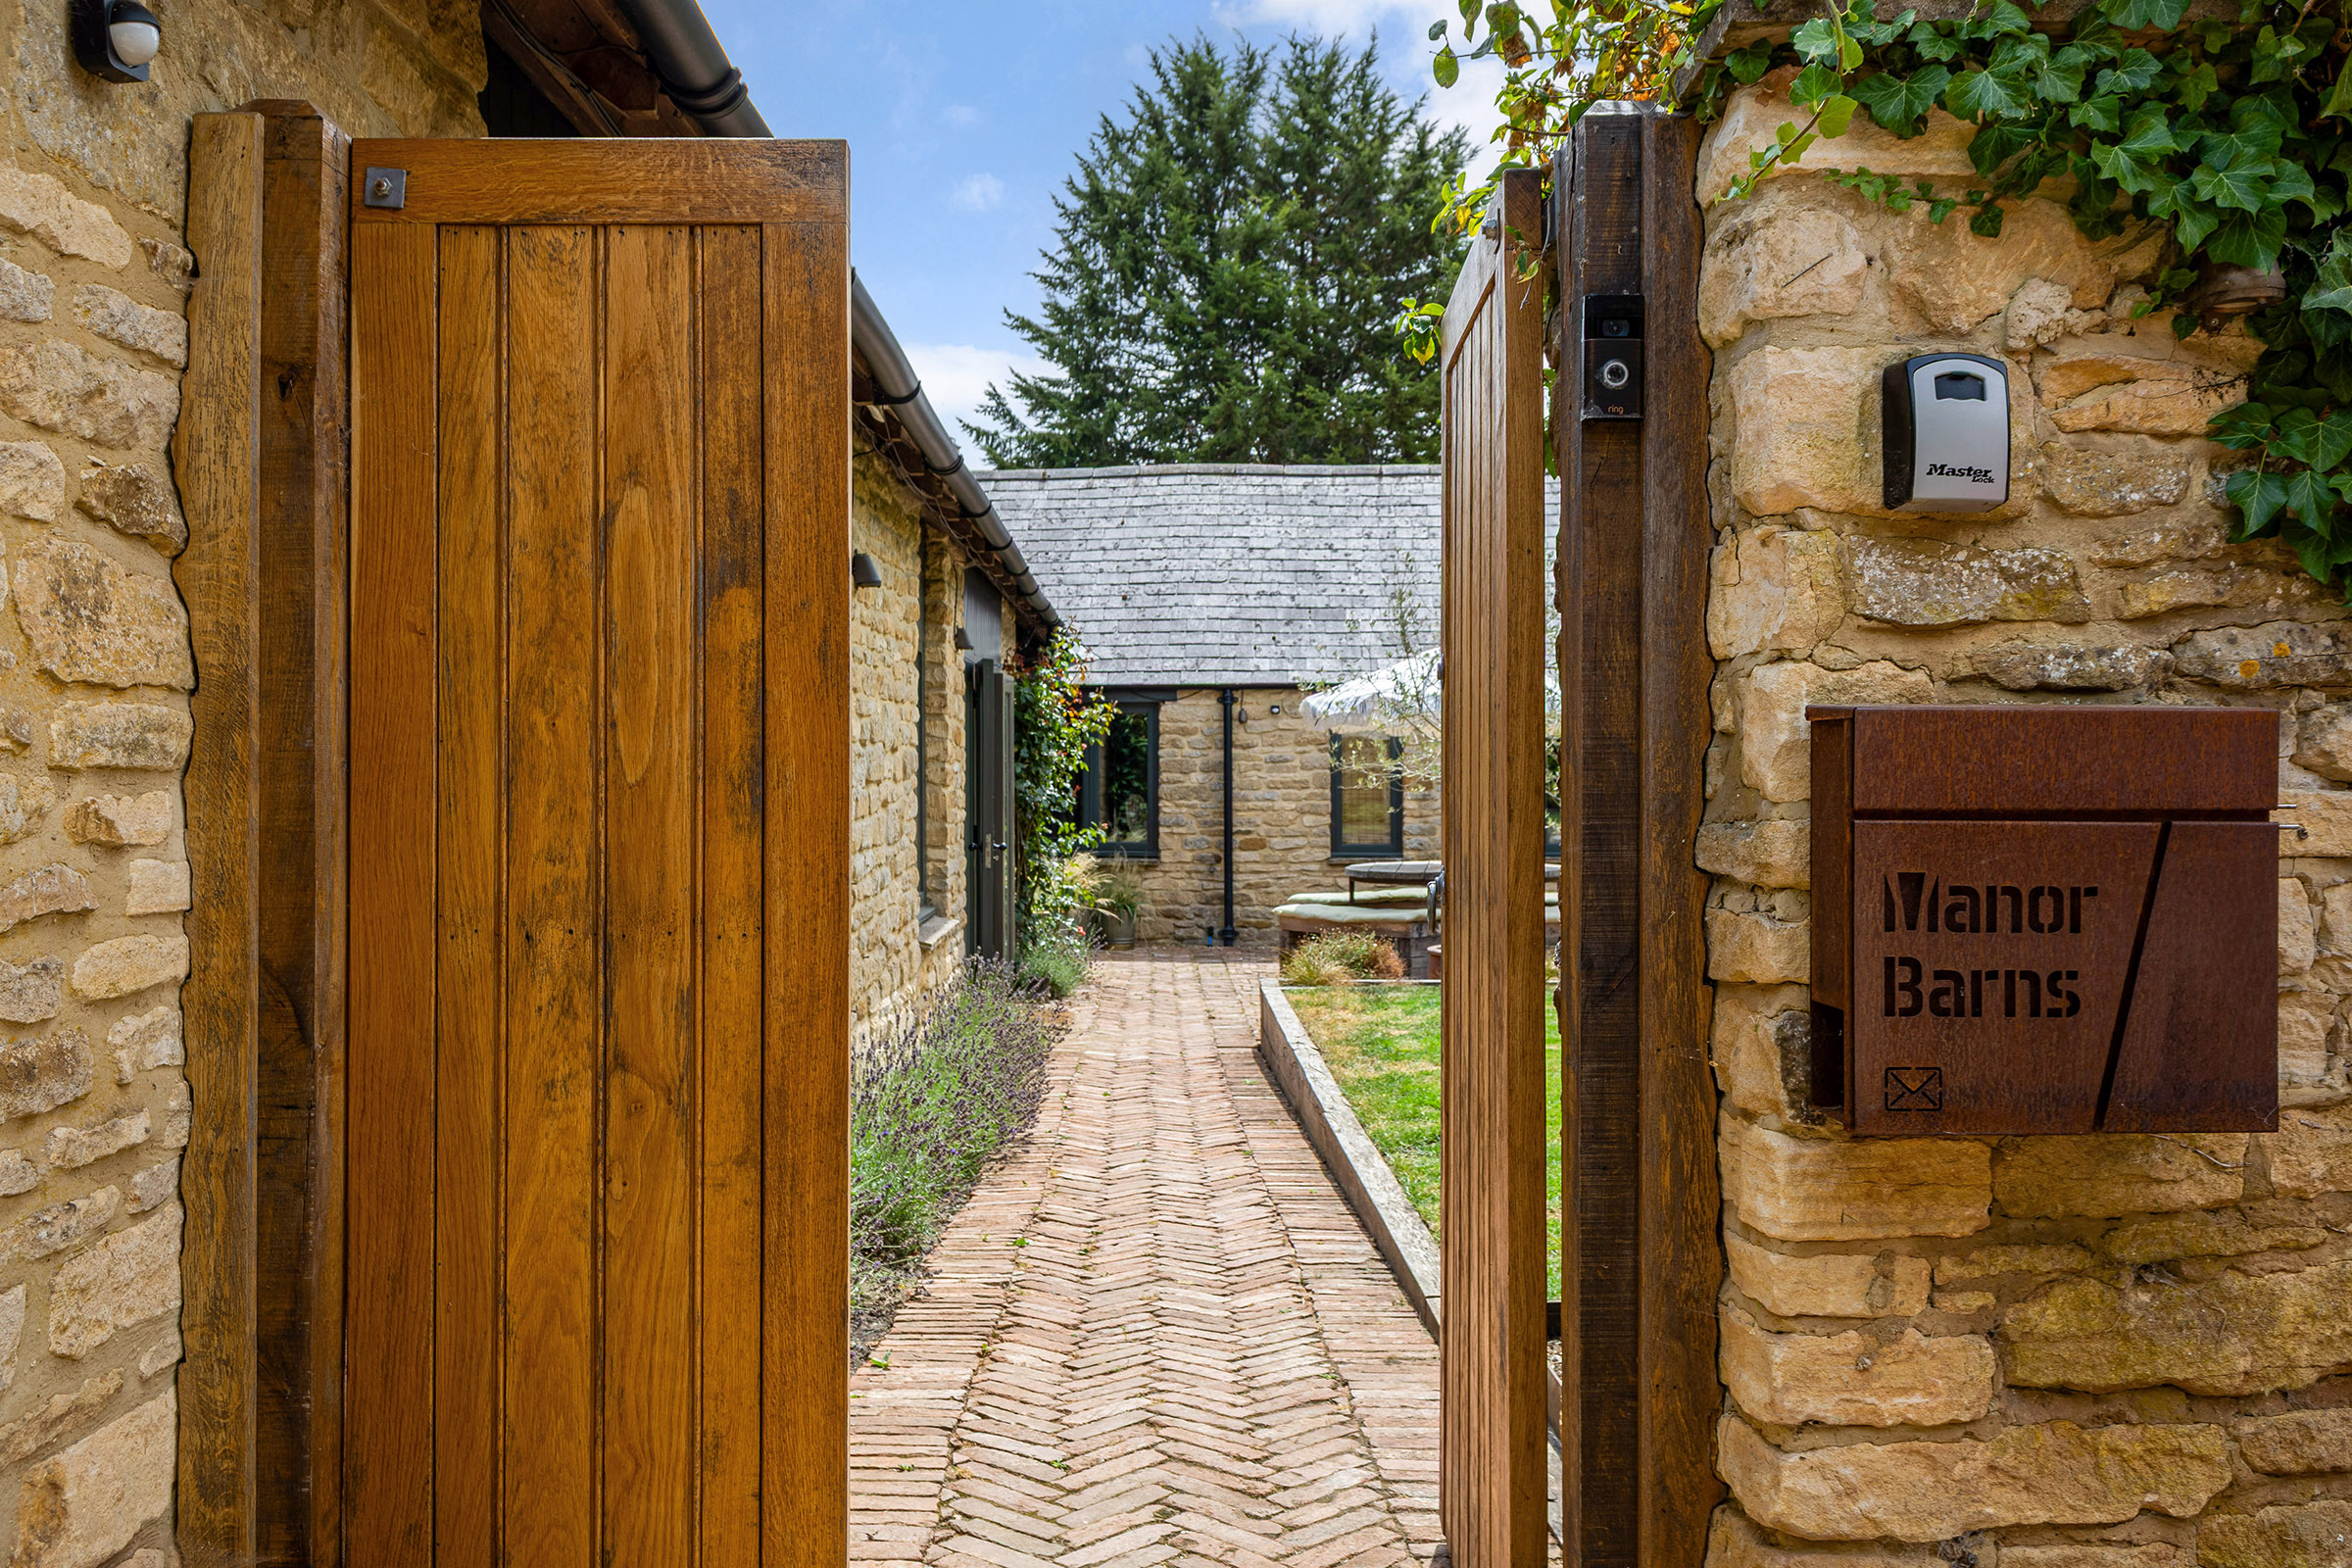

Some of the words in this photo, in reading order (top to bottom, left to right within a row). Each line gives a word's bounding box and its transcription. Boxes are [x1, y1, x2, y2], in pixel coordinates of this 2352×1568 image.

[1607, 404, 1623, 415] ring
[1926, 464, 1992, 477] Master
[1884, 871, 2097, 933] Manor
[1884, 956, 2081, 1017] Barns
